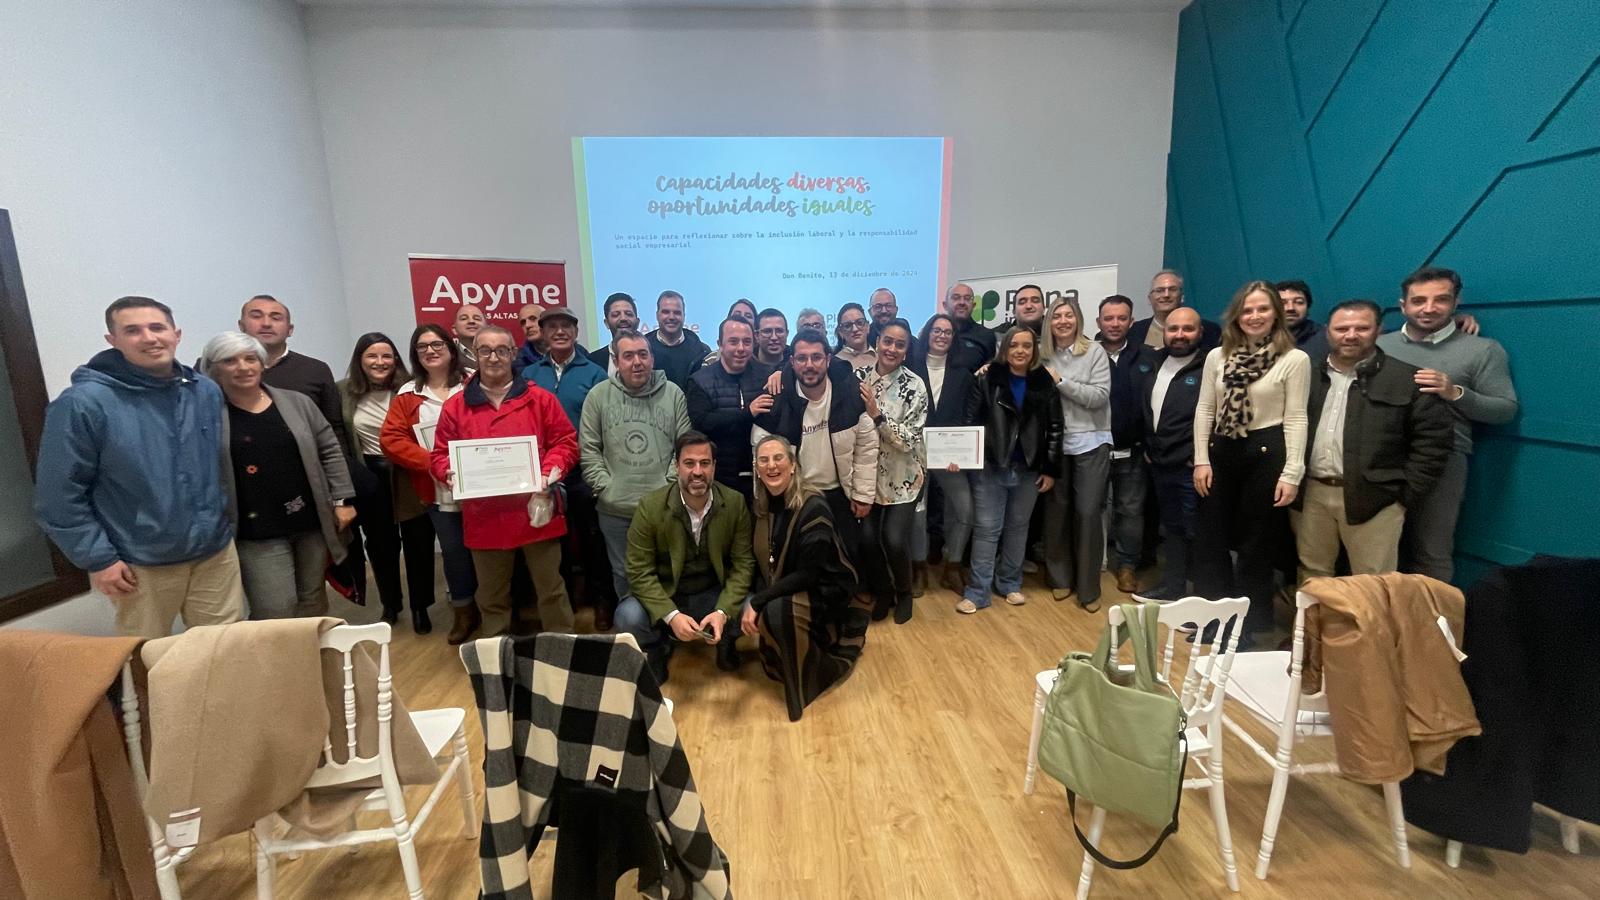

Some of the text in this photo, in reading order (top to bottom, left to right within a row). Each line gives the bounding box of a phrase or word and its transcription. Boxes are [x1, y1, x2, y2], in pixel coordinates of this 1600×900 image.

[656, 172, 871, 195] Capacidades diversas,
[647, 195, 876, 219] oportunidades iguales
[627, 234, 658, 242] espacio
[661, 234, 679, 242] para
[682, 232, 728, 240] reflexionar
[756, 231, 765, 239] la
[768, 230, 805, 238] inclusión
[808, 230, 836, 238] laboral
[859, 229, 918, 238] responsabilidad
[645, 241, 691, 249] empresarial
[782, 272, 795, 280] Don
[829, 271, 838, 279] 13
[852, 270, 888, 278] diciembre
[429, 275, 561, 311] Apyme
